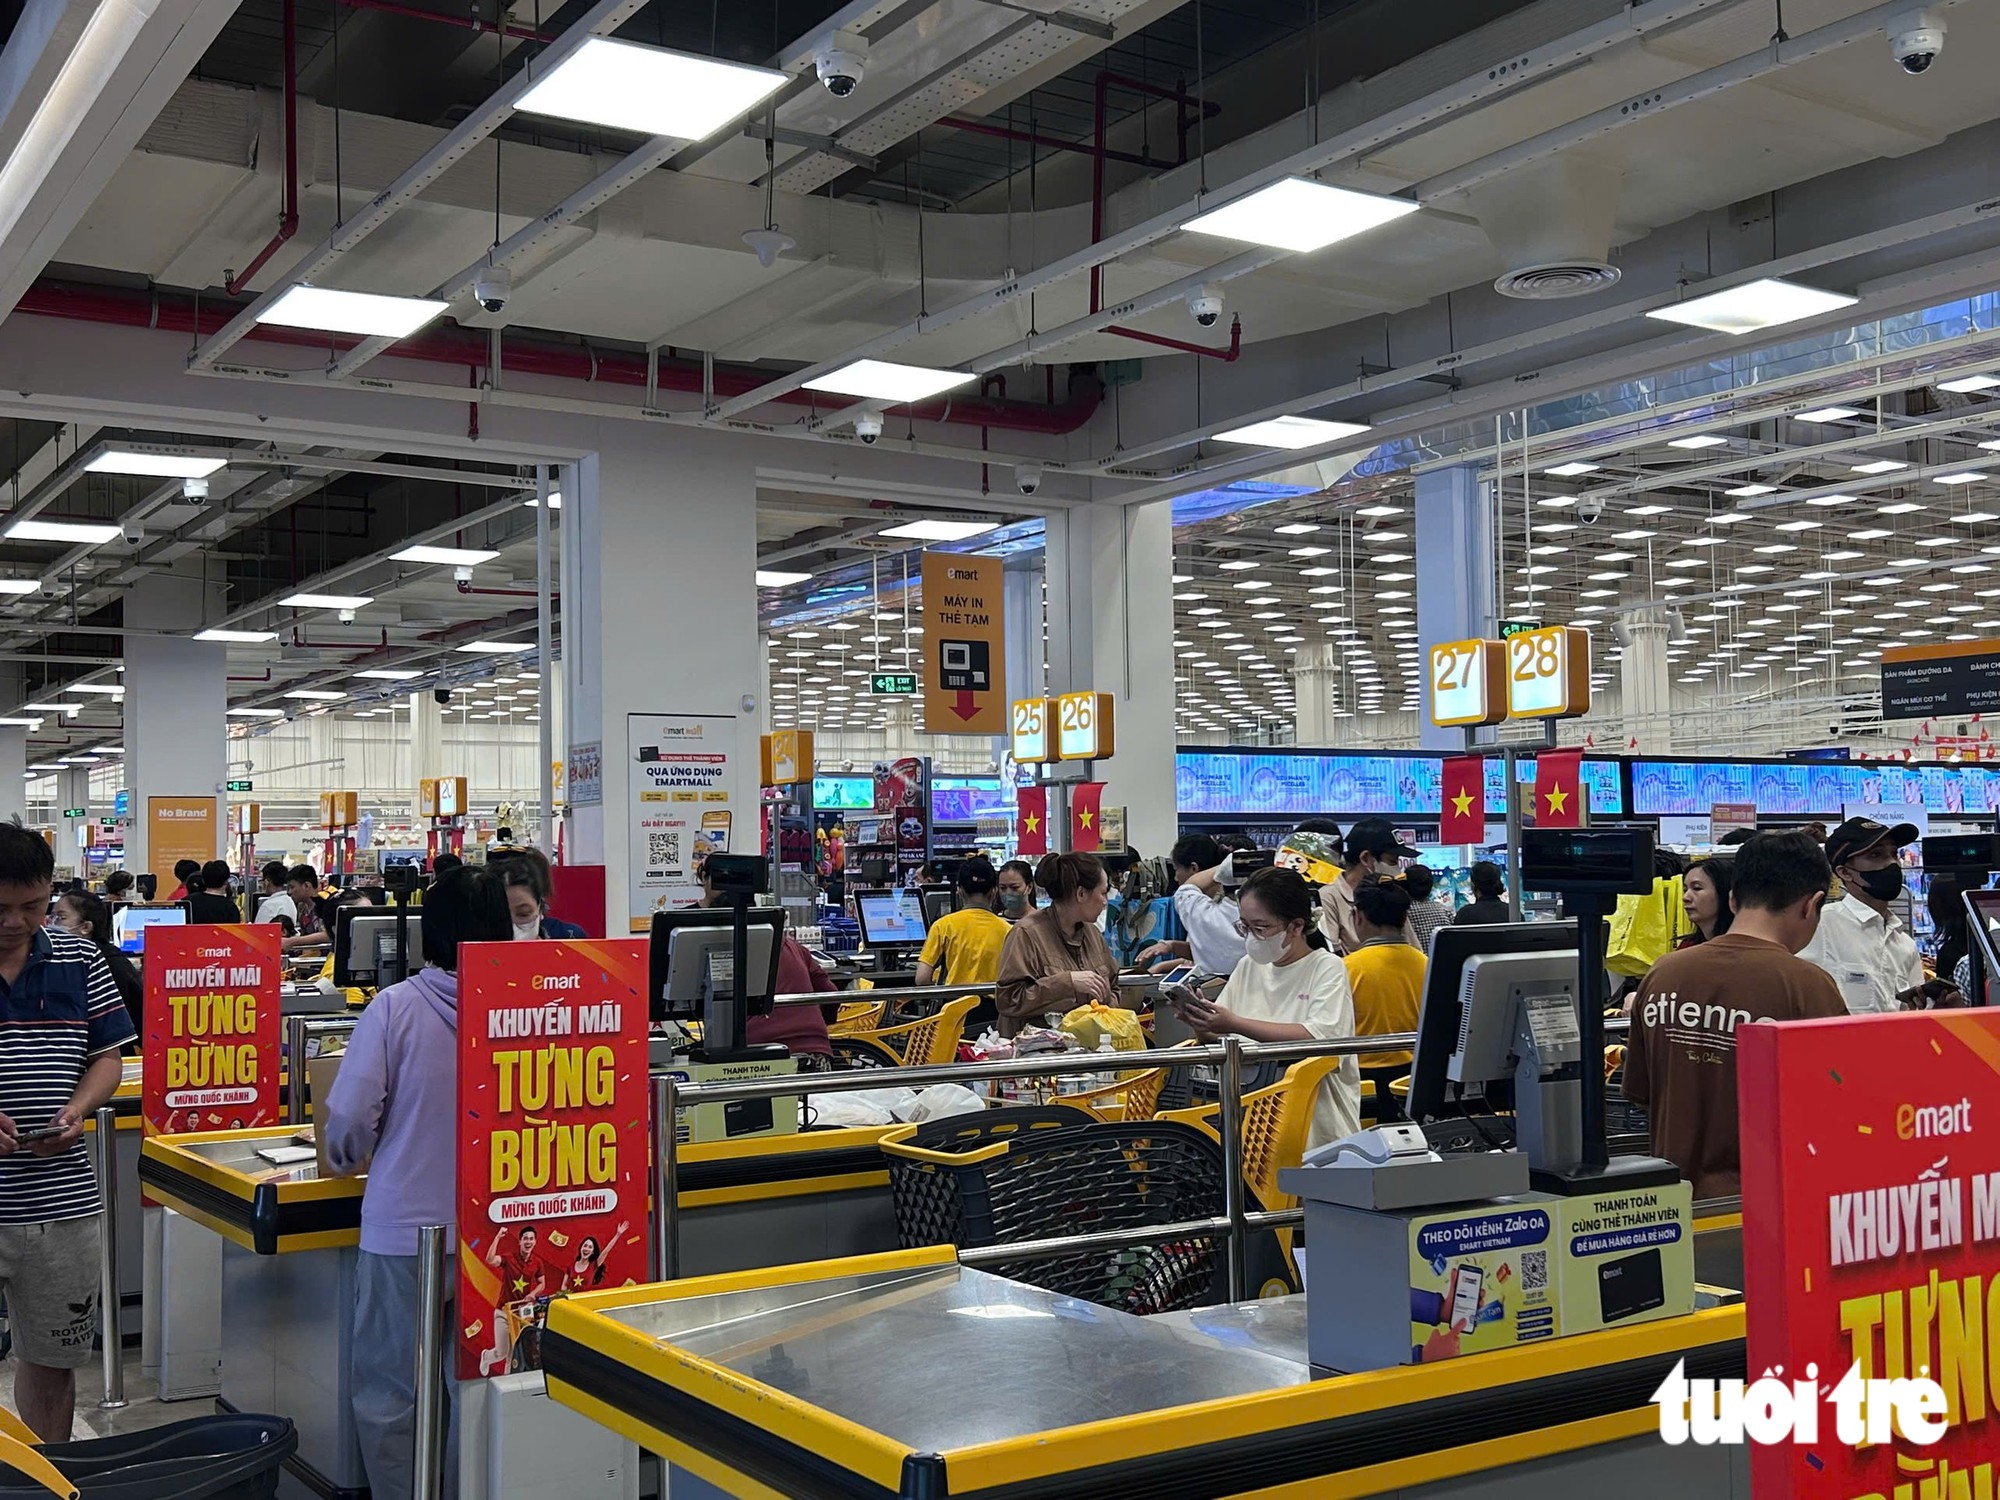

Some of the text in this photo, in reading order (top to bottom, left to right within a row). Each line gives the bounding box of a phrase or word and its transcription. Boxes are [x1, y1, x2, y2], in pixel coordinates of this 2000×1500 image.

[947, 567, 978, 580] emart
[944, 594, 983, 608] MÁY IN
[939, 610, 989, 628] THẺ TẠM
[1437, 646, 1476, 691] 27
[1504, 635, 1558, 681] 28
[1016, 702, 1041, 736] 25
[1063, 697, 1091, 731] 26
[646, 765, 722, 778] QUA ỨNG DỤNG
[655, 778, 712, 786] EMARTMALL
[158, 808, 208, 817] No Brand
[196, 946, 231, 957] emart
[165, 962, 261, 988] KHUYẾN MÃI
[531, 973, 581, 990] emart
[168, 991, 256, 1036] TƯNG
[488, 997, 621, 1039] KHUYẾN MÃI
[1643, 992, 1776, 1032] étienn
[167, 1038, 258, 1088] BỪNG
[723, 1065, 770, 1075] THANH TOÁN
[492, 1042, 615, 1112] TƯNG
[174, 1090, 249, 1105] MỪNG QUỐC KHÁNH
[1896, 1097, 1972, 1140] emart
[490, 1115, 617, 1193] BỪNG
[501, 1193, 606, 1219] MỪNG QUỐC KHÁNH
[1594, 1194, 1657, 1214] THANH TOÁN
[1829, 1155, 1962, 1266] KHUYẾN
[1423, 1216, 1544, 1244] THEO DÕI KÊNH Zalo OA
[1572, 1208, 1679, 1233] CÙNG THẺ THÀNH VIÊN
[1459, 1236, 1511, 1251] EMART VIETNAM
[1588, 1239, 1608, 1250] MUA
[1608, 1235, 1632, 1248] HÀNG
[1658, 1228, 1676, 1240] HƠN
